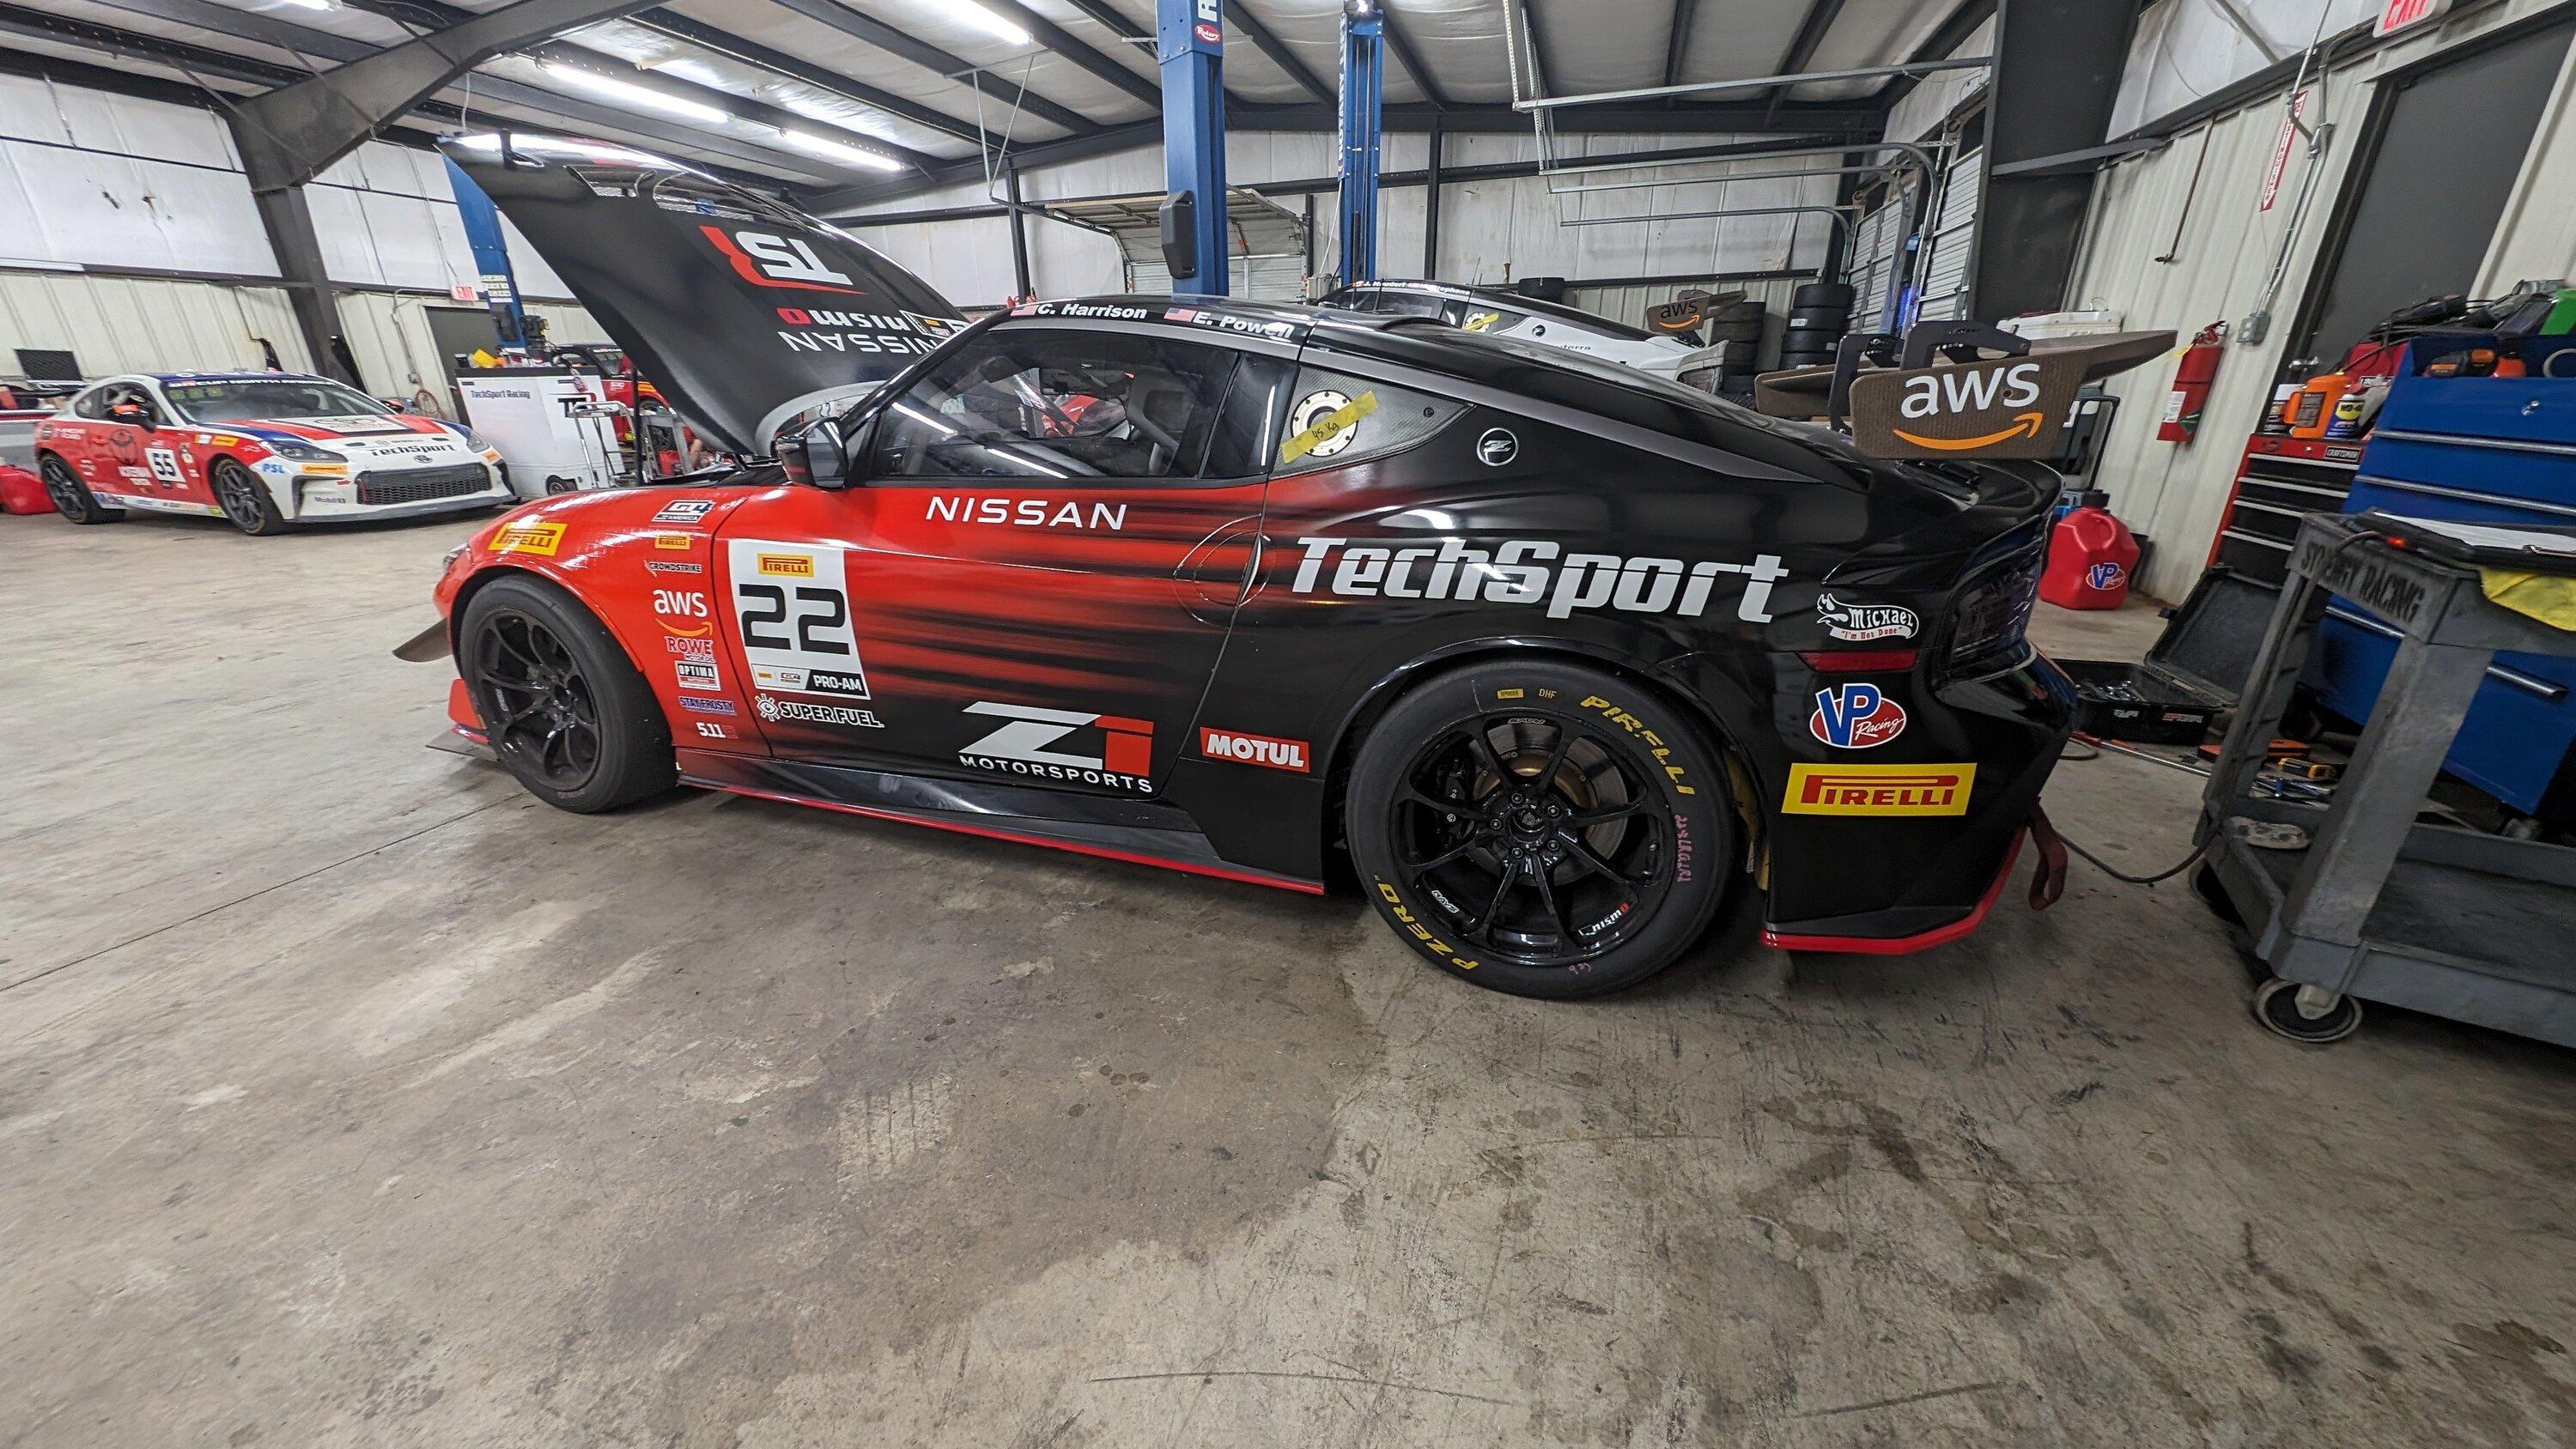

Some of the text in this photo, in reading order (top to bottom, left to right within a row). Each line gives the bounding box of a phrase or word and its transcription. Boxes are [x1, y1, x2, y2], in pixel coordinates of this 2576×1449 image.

[1037, 303, 1148, 319] C. Harrison
[1193, 312, 1212, 324] E.
[1661, 300, 1699, 319] aws
[777, 331, 938, 355] NISSAN
[471, 390, 531, 400] TechSport Racing
[1900, 363, 2040, 419] aws
[1312, 429, 1324, 440] 45
[371, 443, 456, 457] TechSport
[152, 452, 177, 477] 55
[263, 463, 284, 474] PSL
[925, 496, 1127, 530] NISSAN
[496, 528, 557, 549] PIRELLI
[649, 561, 702, 573] CROWDSTRIKE
[762, 557, 809, 573] PIRELLI
[2090, 562, 2119, 590] VP
[1292, 537, 1789, 623] TechSport
[652, 589, 708, 618] aws
[738, 583, 850, 655] 22
[666, 637, 713, 656] ROWE
[677, 664, 714, 679] OPTIMA
[813, 674, 863, 692] PRO-AM
[1539, 688, 1558, 699] DHF
[1815, 683, 1882, 748] VP
[696, 722, 726, 738] 5.11
[1855, 718, 1905, 740] Racing
[1206, 733, 1305, 768] MOTUL
[1580, 695, 1696, 796] PIRELLI
[958, 755, 1154, 793] MOTORSPORTS
[1801, 774, 1959, 806] PIRELLI
[1376, 882, 1479, 970] P ZERO
[1591, 902, 1630, 933] nismo
